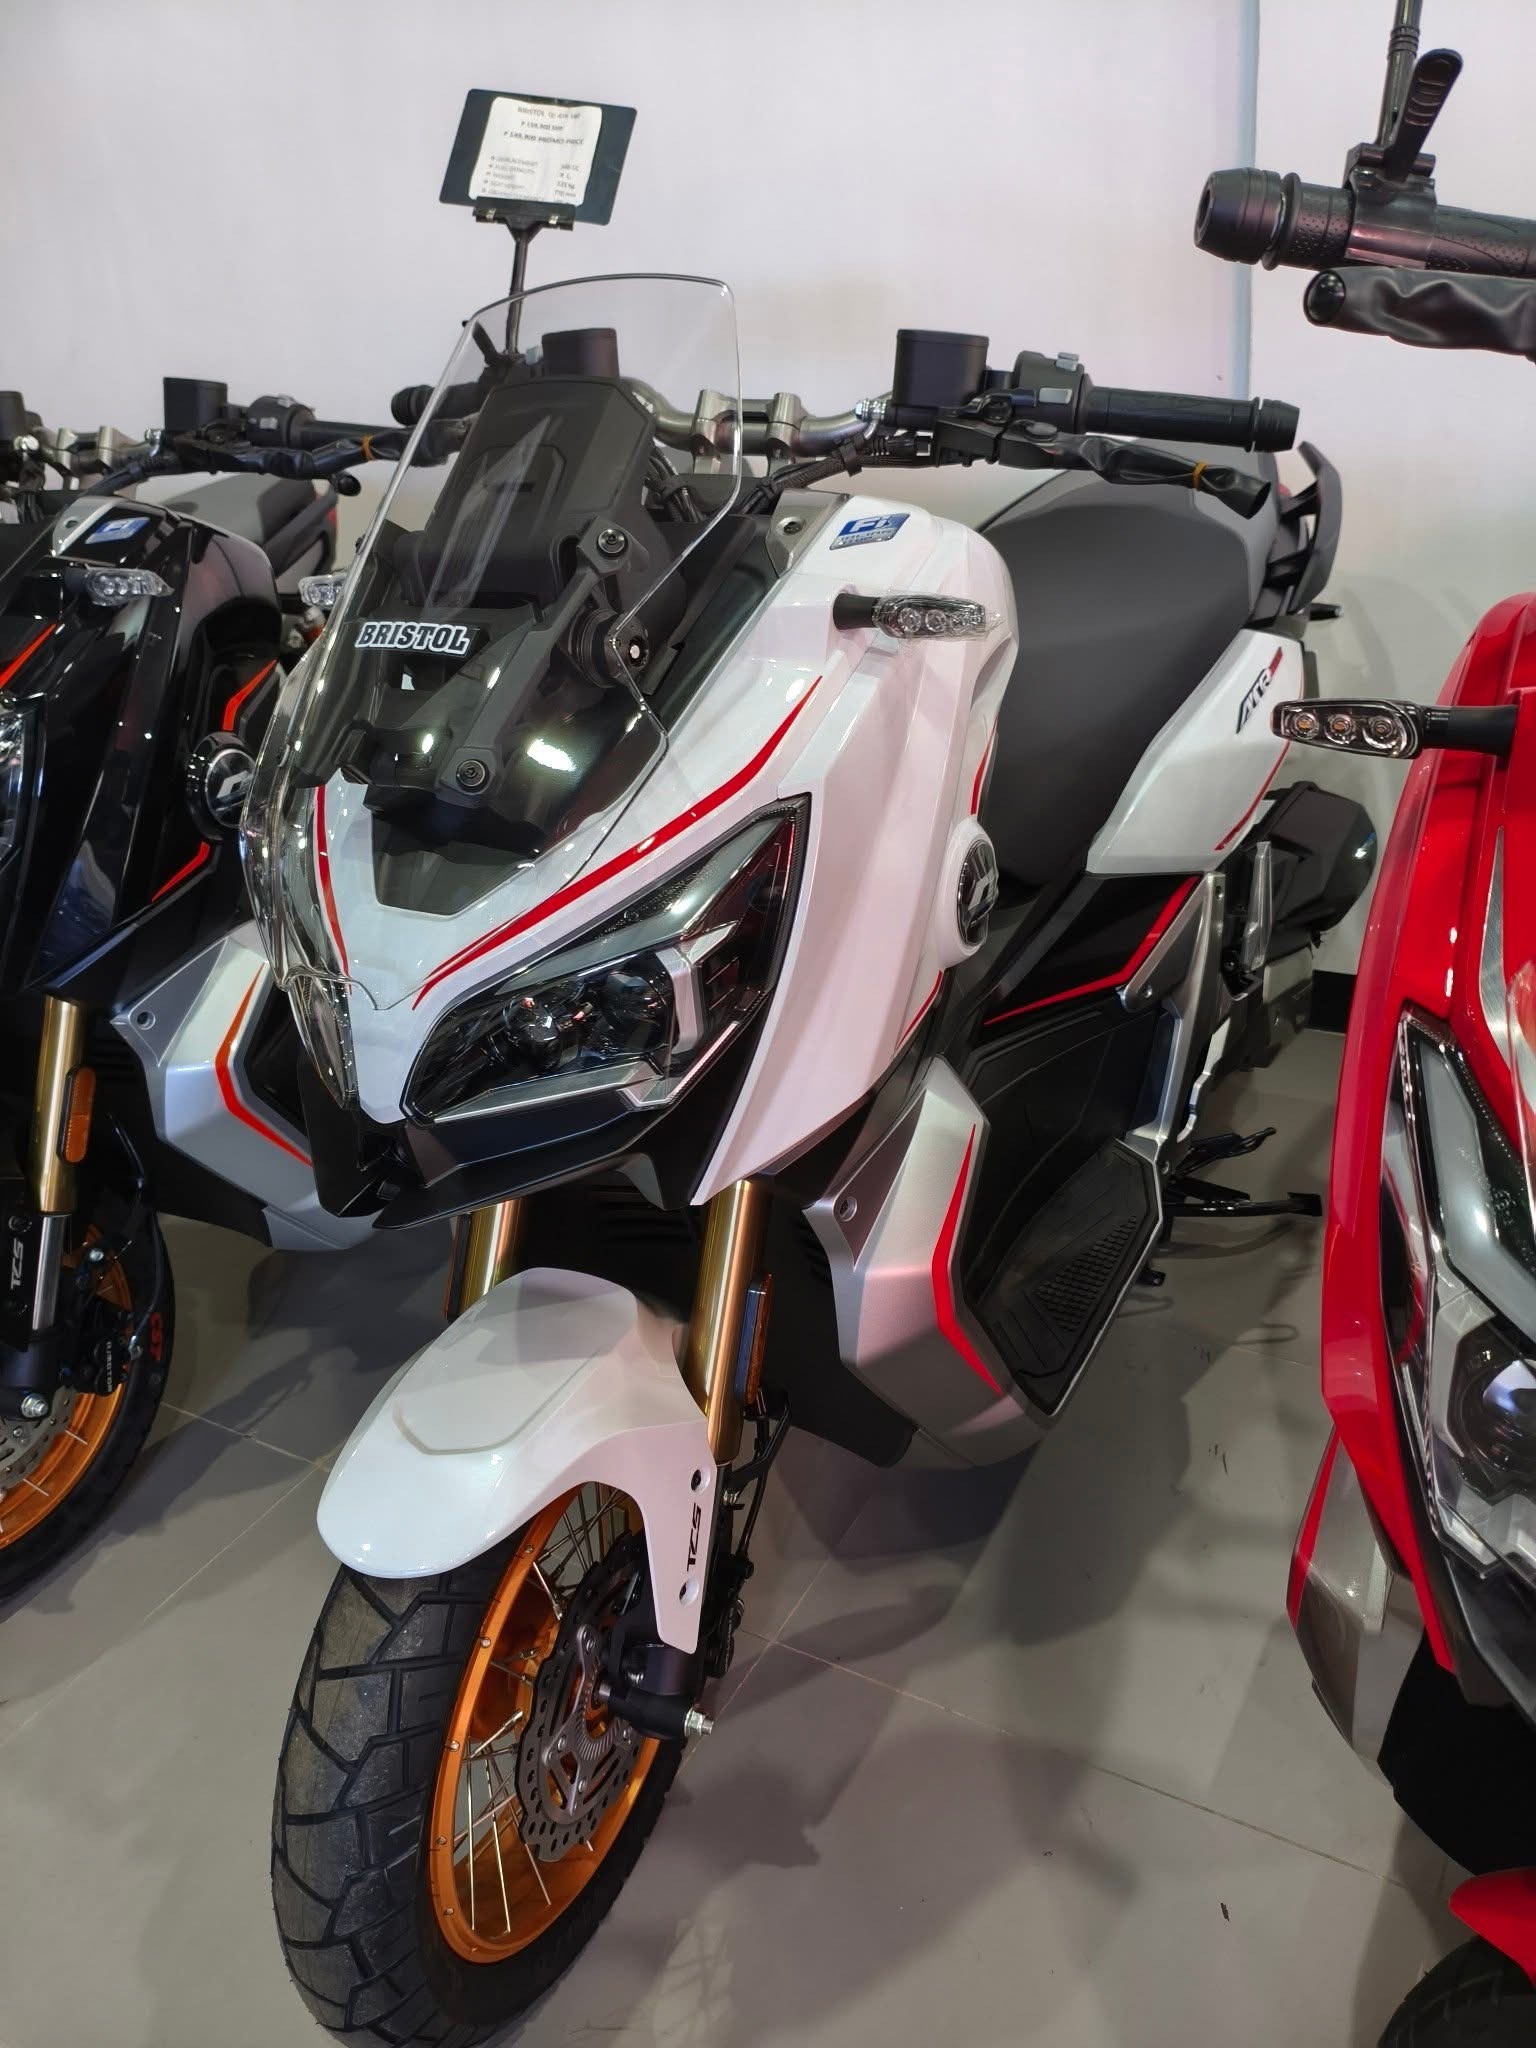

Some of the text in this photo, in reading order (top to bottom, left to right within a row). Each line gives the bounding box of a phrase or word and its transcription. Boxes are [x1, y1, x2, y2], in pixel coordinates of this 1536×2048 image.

[354, 621, 470, 655] BRISTOL
[9, 1237, 25, 1290] TCS
[686, 1502, 702, 1572] TCS
